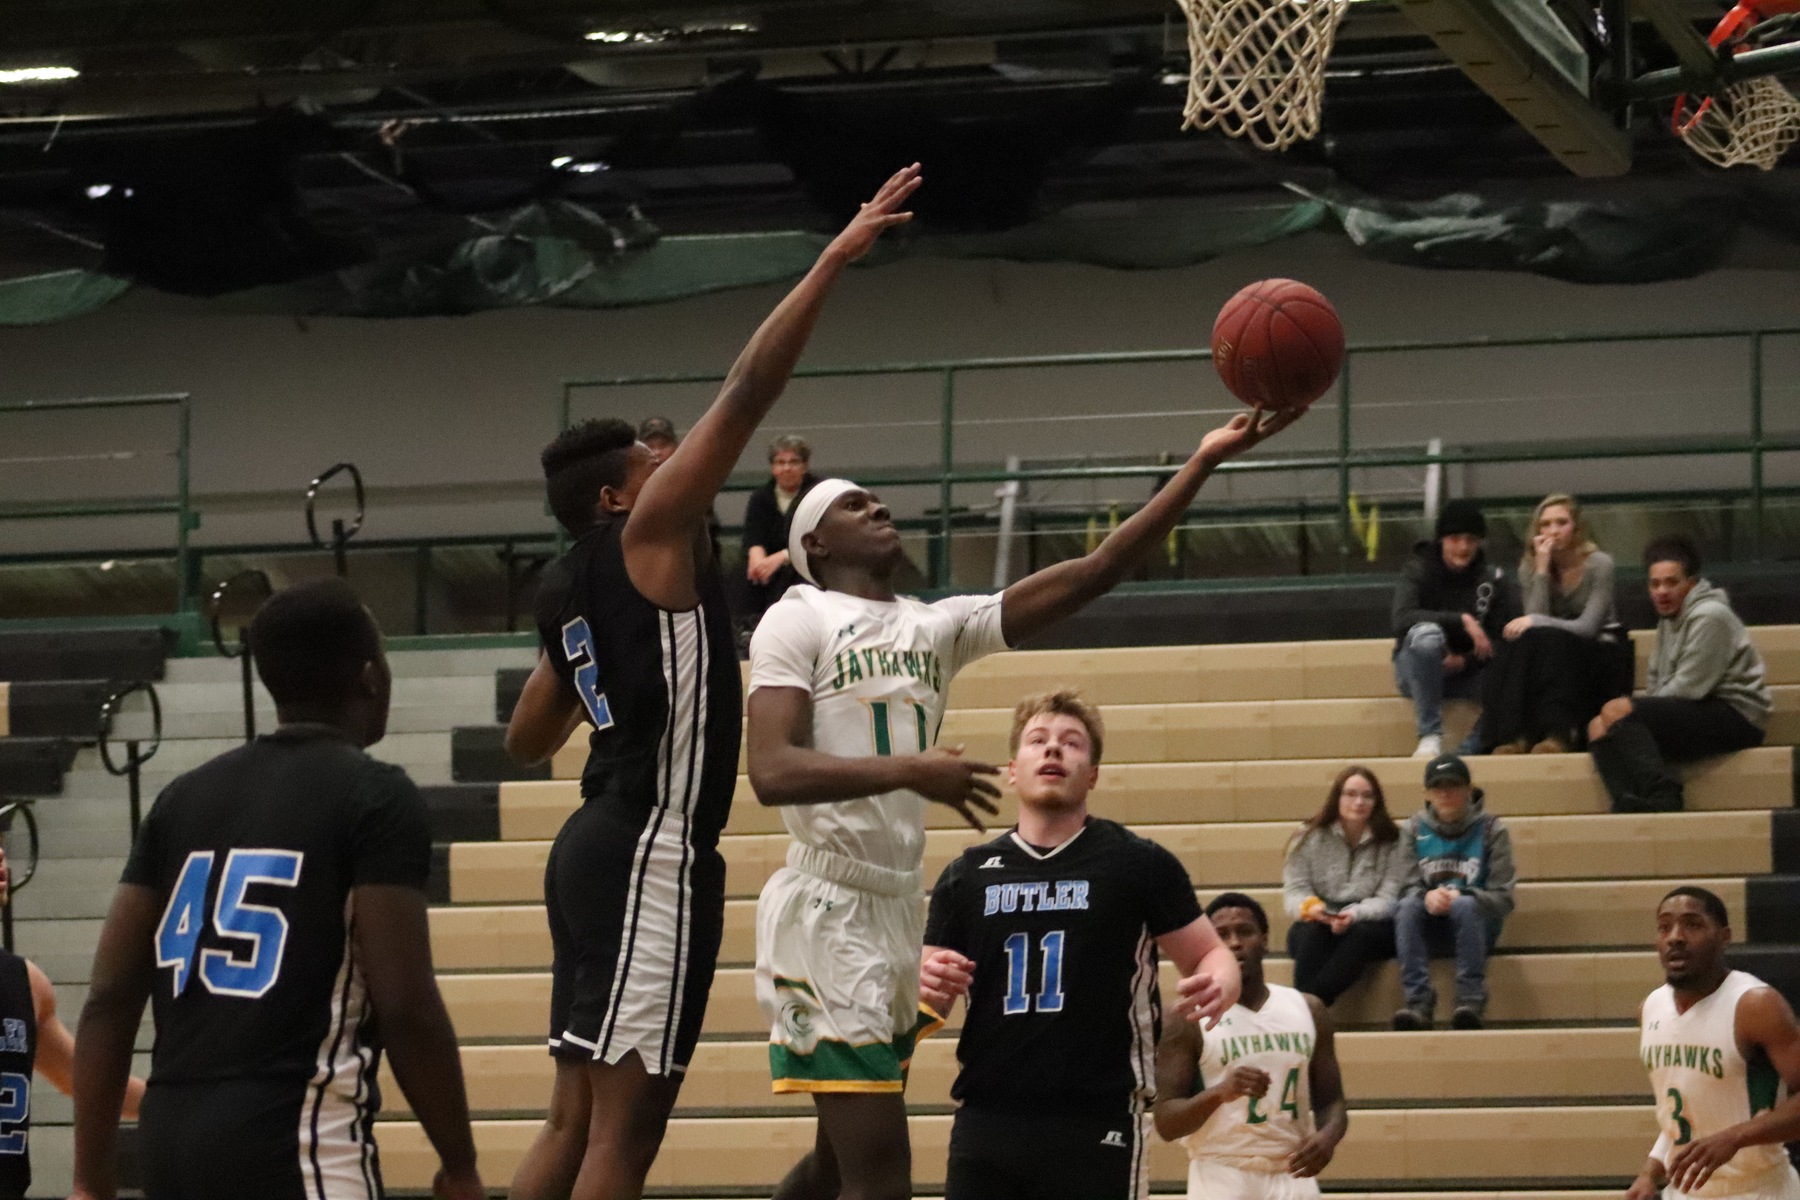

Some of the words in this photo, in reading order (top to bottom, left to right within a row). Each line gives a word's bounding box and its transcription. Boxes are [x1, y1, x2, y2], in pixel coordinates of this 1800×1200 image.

[562, 615, 615, 731] 2
[833, 648, 942, 693] JAYHAWKS
[154, 848, 304, 998] 45
[983, 879, 1089, 916] BUTLER
[1003, 930, 1065, 1015] 11
[1666, 1086, 1693, 1146] 3
